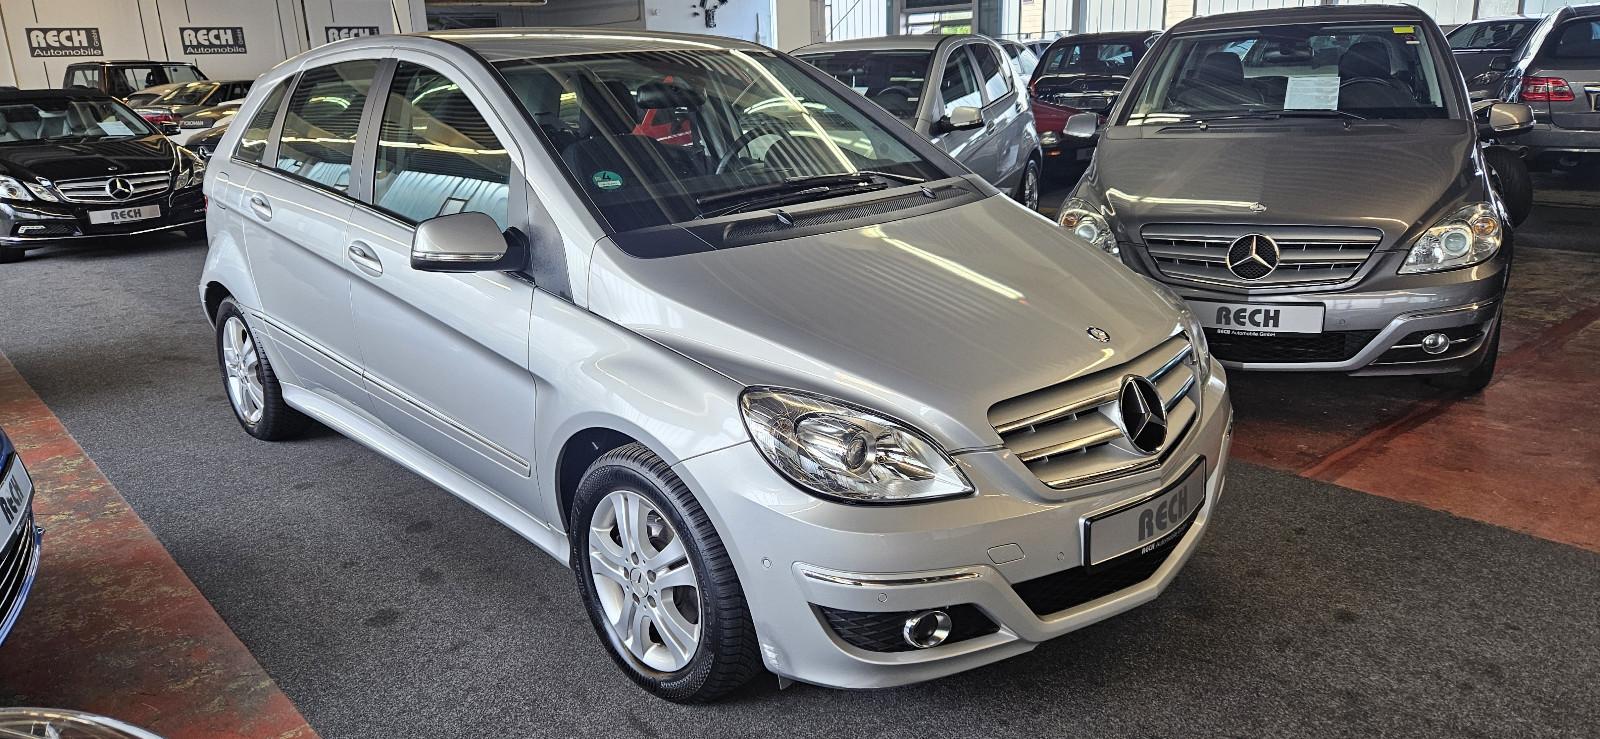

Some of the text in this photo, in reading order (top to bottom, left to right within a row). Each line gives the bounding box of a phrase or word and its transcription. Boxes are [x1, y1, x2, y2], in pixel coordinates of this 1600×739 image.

[30, 30, 88, 47] RECH
[183, 29, 234, 45] RECH
[34, 48, 101, 56] Automobile
[111, 208, 142, 220] RECH
[1216, 306, 1280, 327] RECH
[1139, 485, 1187, 541] RECH
